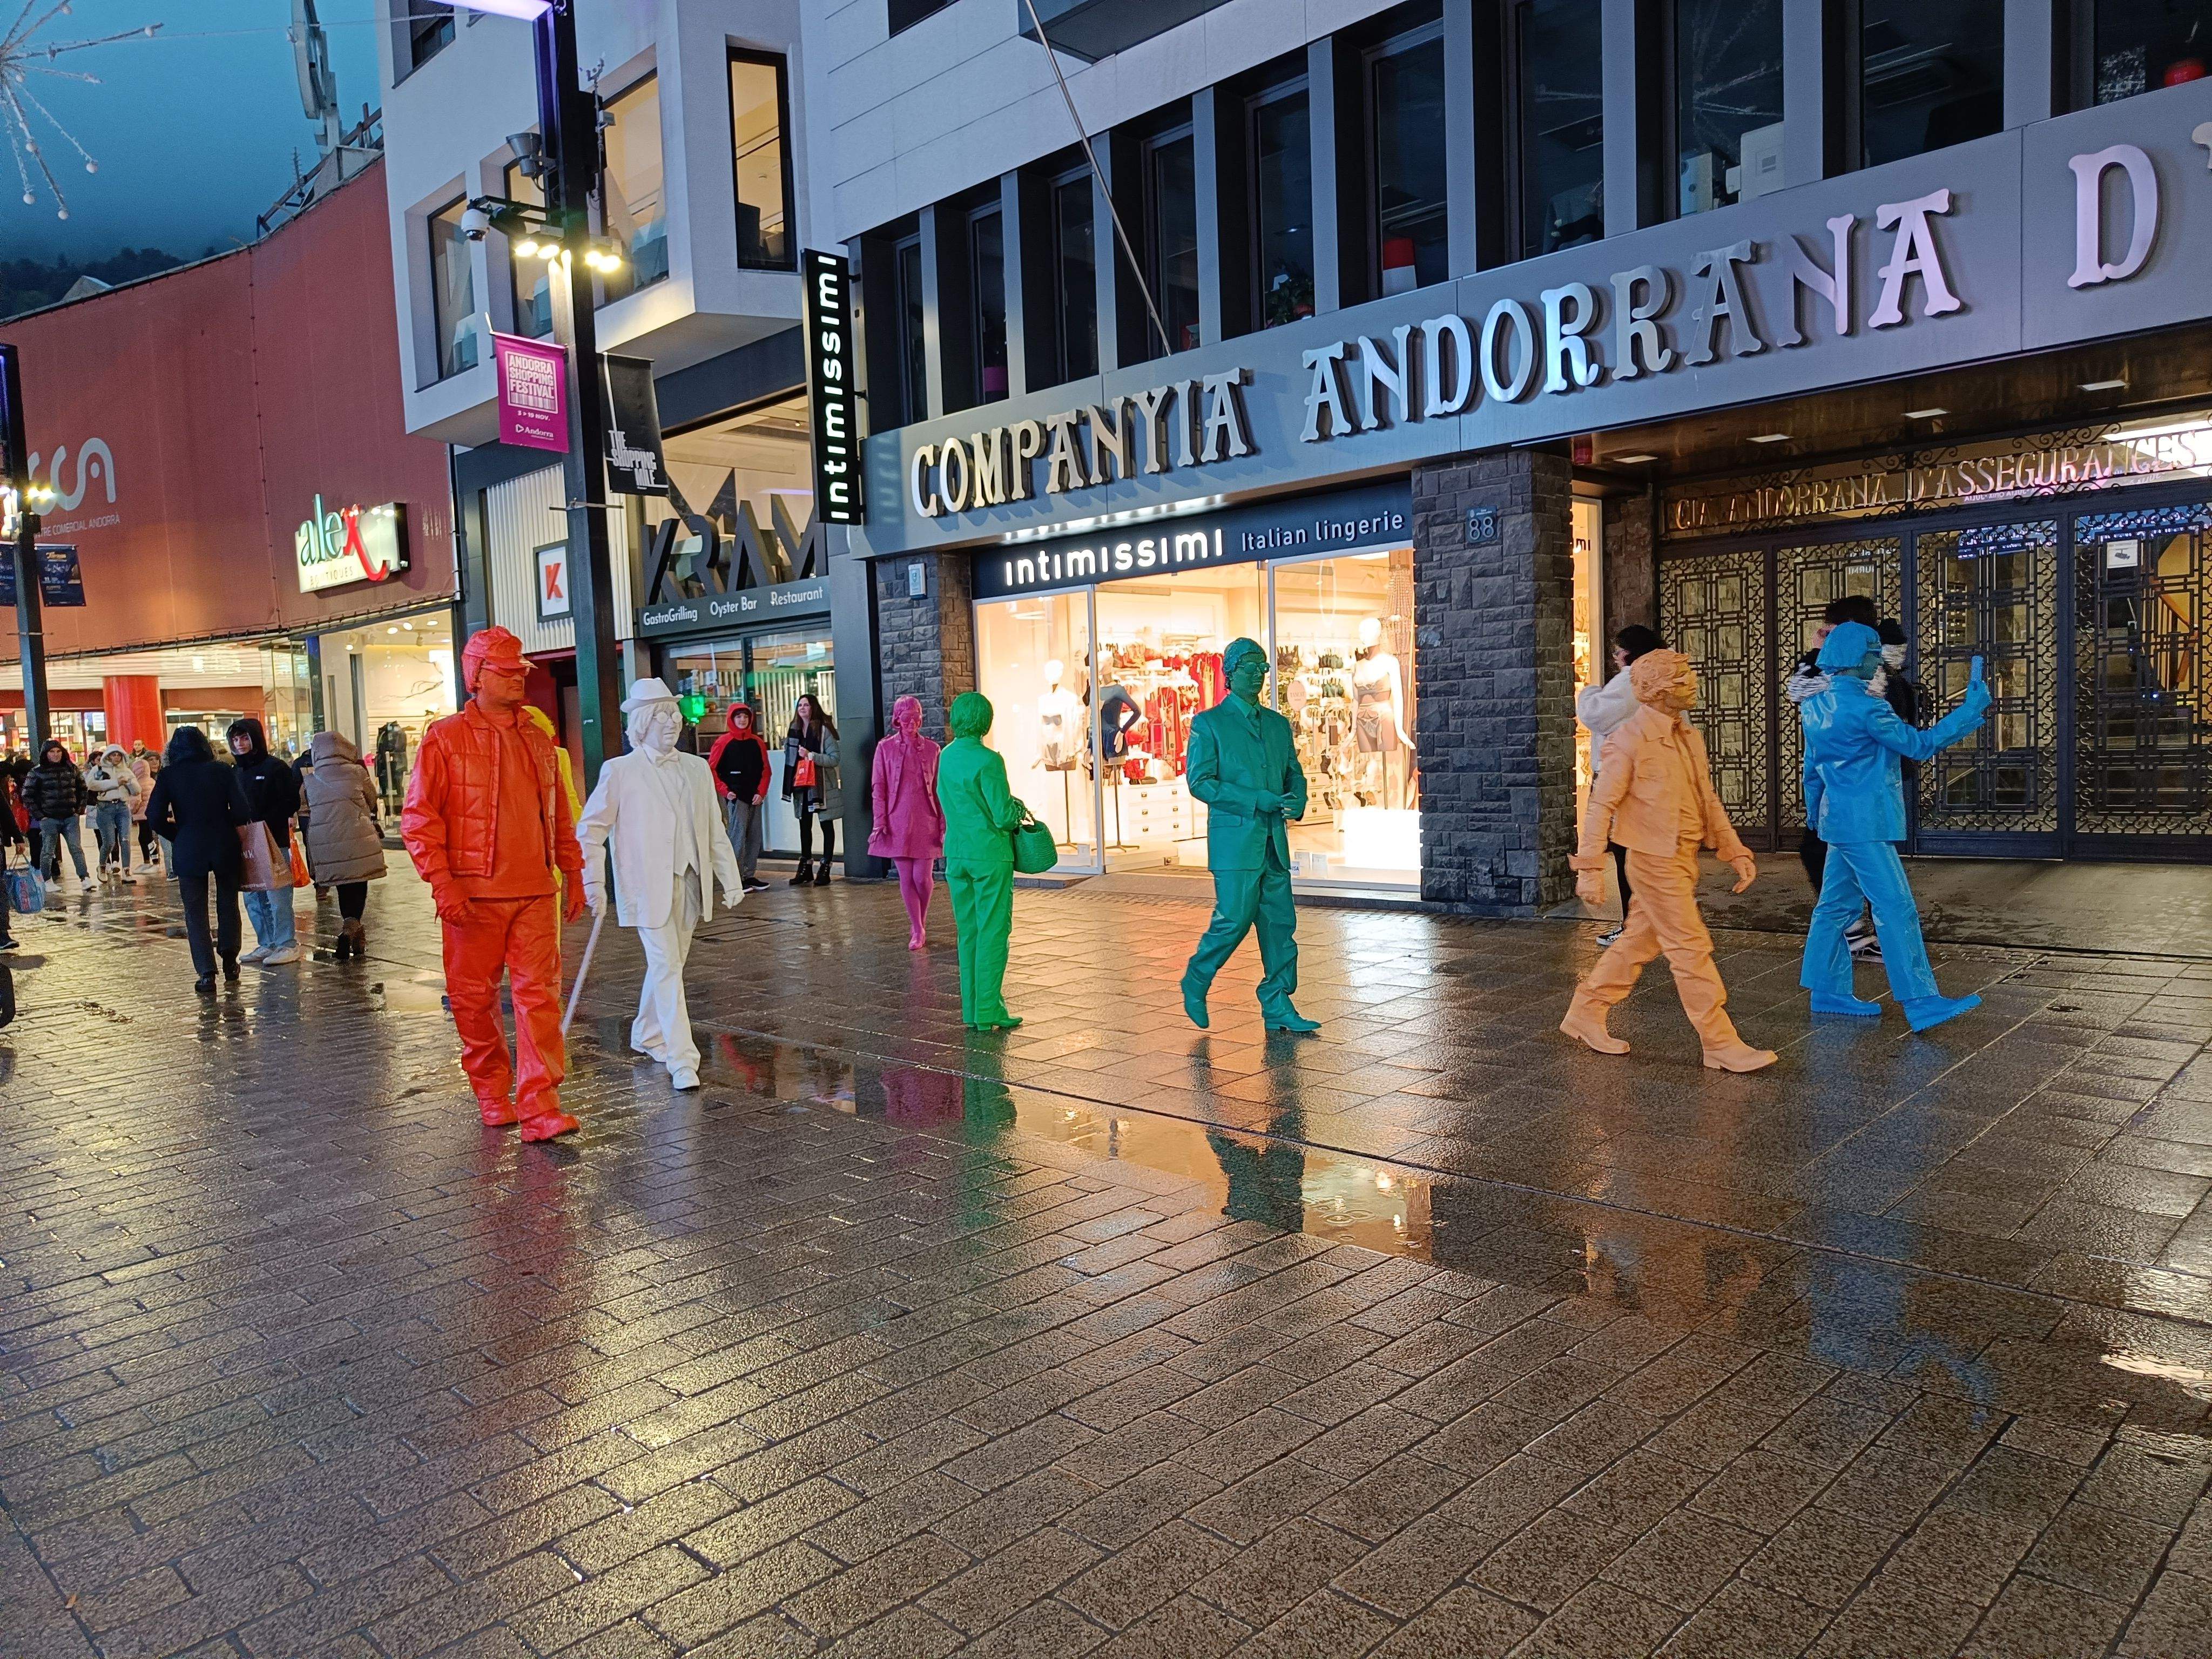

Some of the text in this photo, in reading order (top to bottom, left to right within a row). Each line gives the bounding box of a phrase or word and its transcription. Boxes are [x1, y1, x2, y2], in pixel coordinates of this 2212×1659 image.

[509, 355, 553, 374] ANDORRA
[911, 367, 1249, 518] COMPANYIA
[1299, 188, 1963, 443] ANDORRANA
[510, 367, 554, 386] SHOPPING
[510, 379, 555, 399] FESTIVAL
[524, 427, 554, 438] Andorra
[608, 430, 628, 450] THE
[611, 448, 657, 470] SHOPPING
[299, 494, 389, 581] alex
[1242, 524, 1306, 552] Italian
[1316, 510, 1405, 542] lingerie
[1469, 516, 1494, 540] 88
[545, 563, 564, 600] K
[643, 586, 823, 626] GastroGrilling Oyster Bar Restaurant
